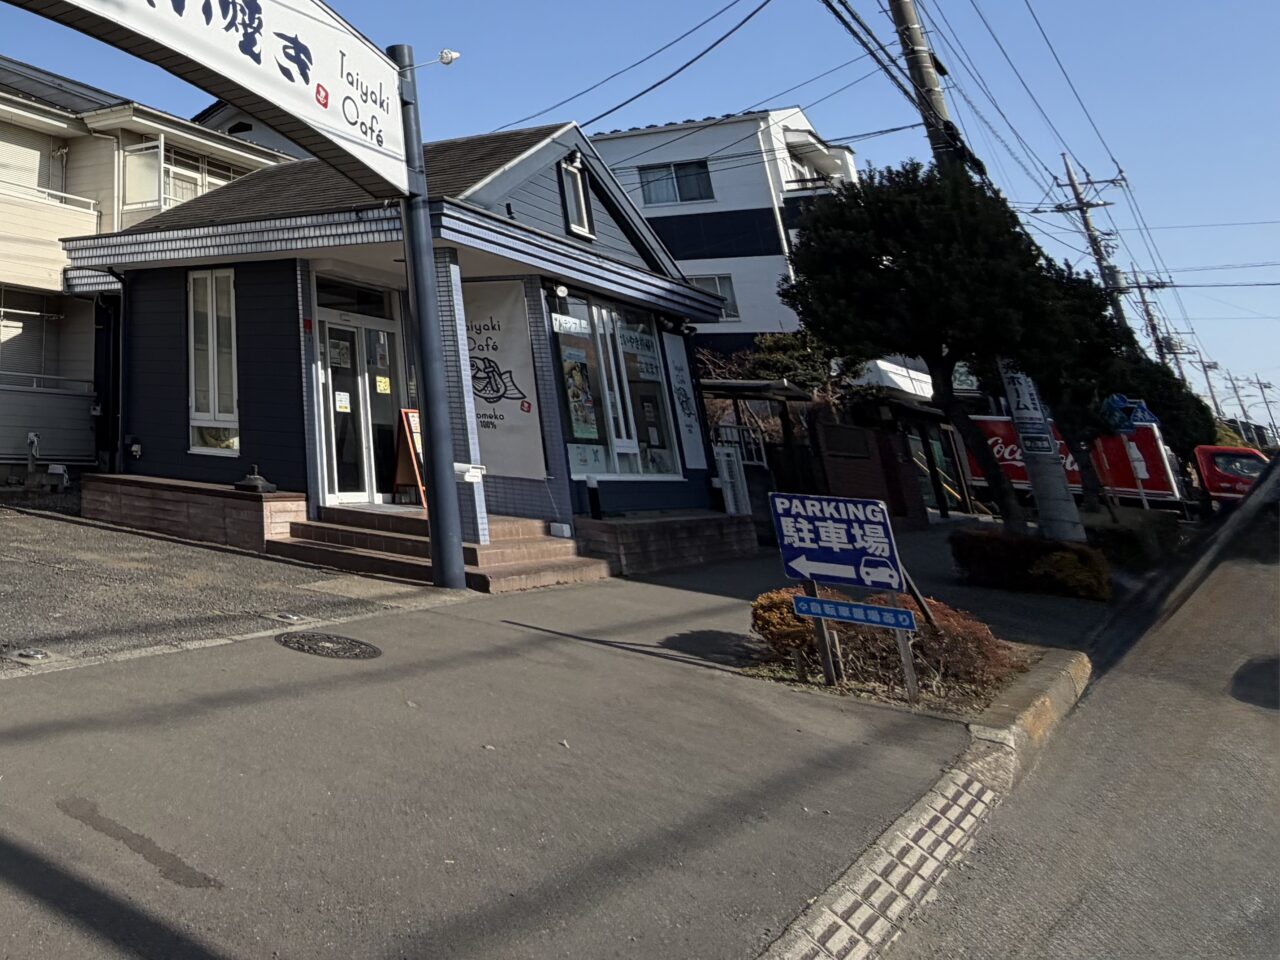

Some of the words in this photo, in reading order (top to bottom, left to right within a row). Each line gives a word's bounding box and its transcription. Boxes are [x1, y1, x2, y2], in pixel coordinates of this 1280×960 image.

[339, 50, 389, 114] Taiyaki
[342, 95, 384, 147] Café
[476, 408, 505, 420] omeko
[479, 420, 497, 430] 100%
[775, 497, 885, 523] PARKING
[780, 517, 890, 557] 駐車場
